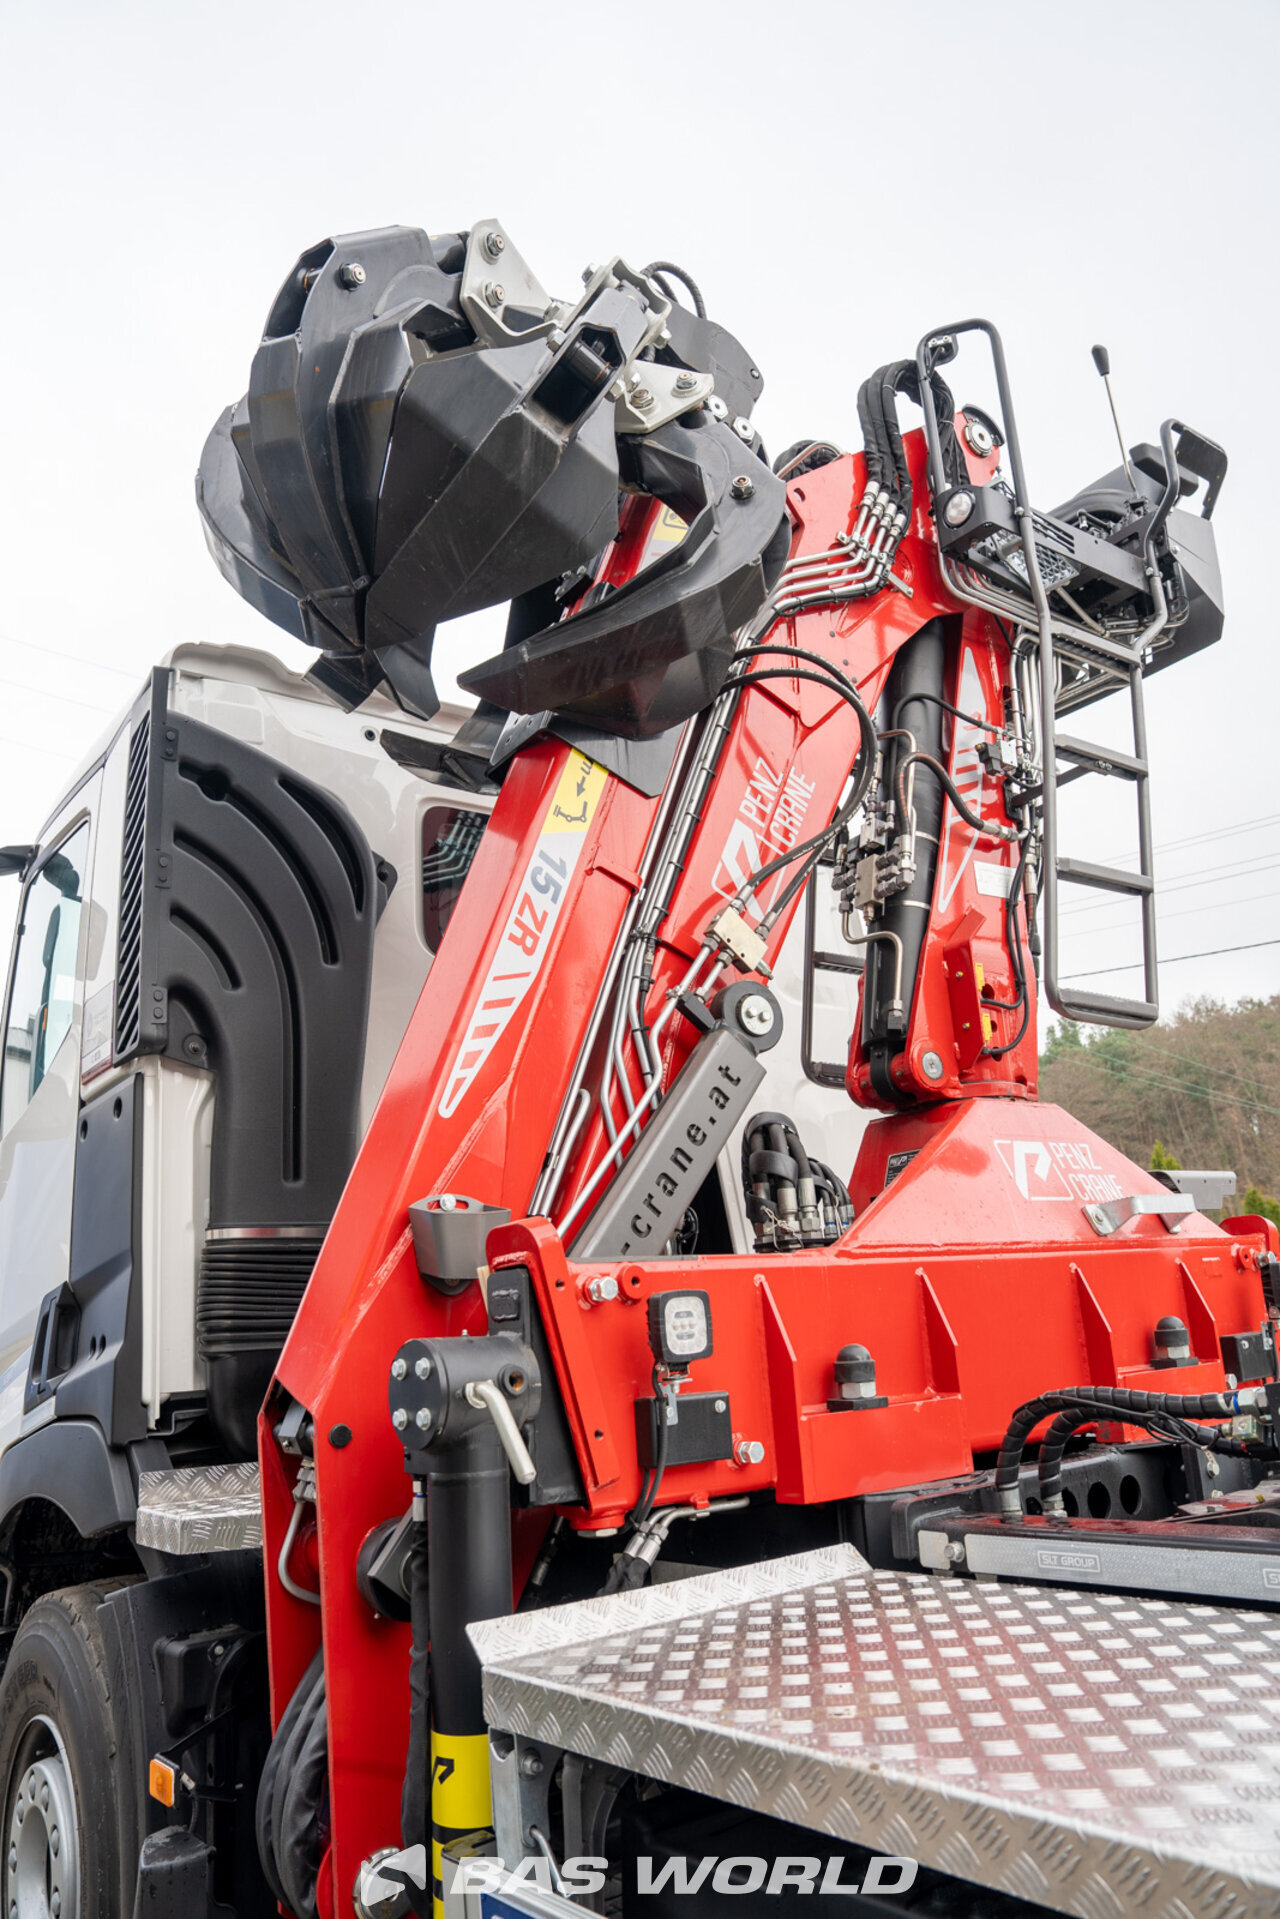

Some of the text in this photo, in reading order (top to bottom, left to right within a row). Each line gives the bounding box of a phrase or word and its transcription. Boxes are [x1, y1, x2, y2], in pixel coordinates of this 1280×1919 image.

[739, 756, 784, 828] PENZ
[770, 766, 816, 847] CRANE
[508, 849, 567, 956] 15 ZR
[1048, 1142, 1102, 1169] PENZ
[1042, 1554, 1095, 1568] SLT GROUP
